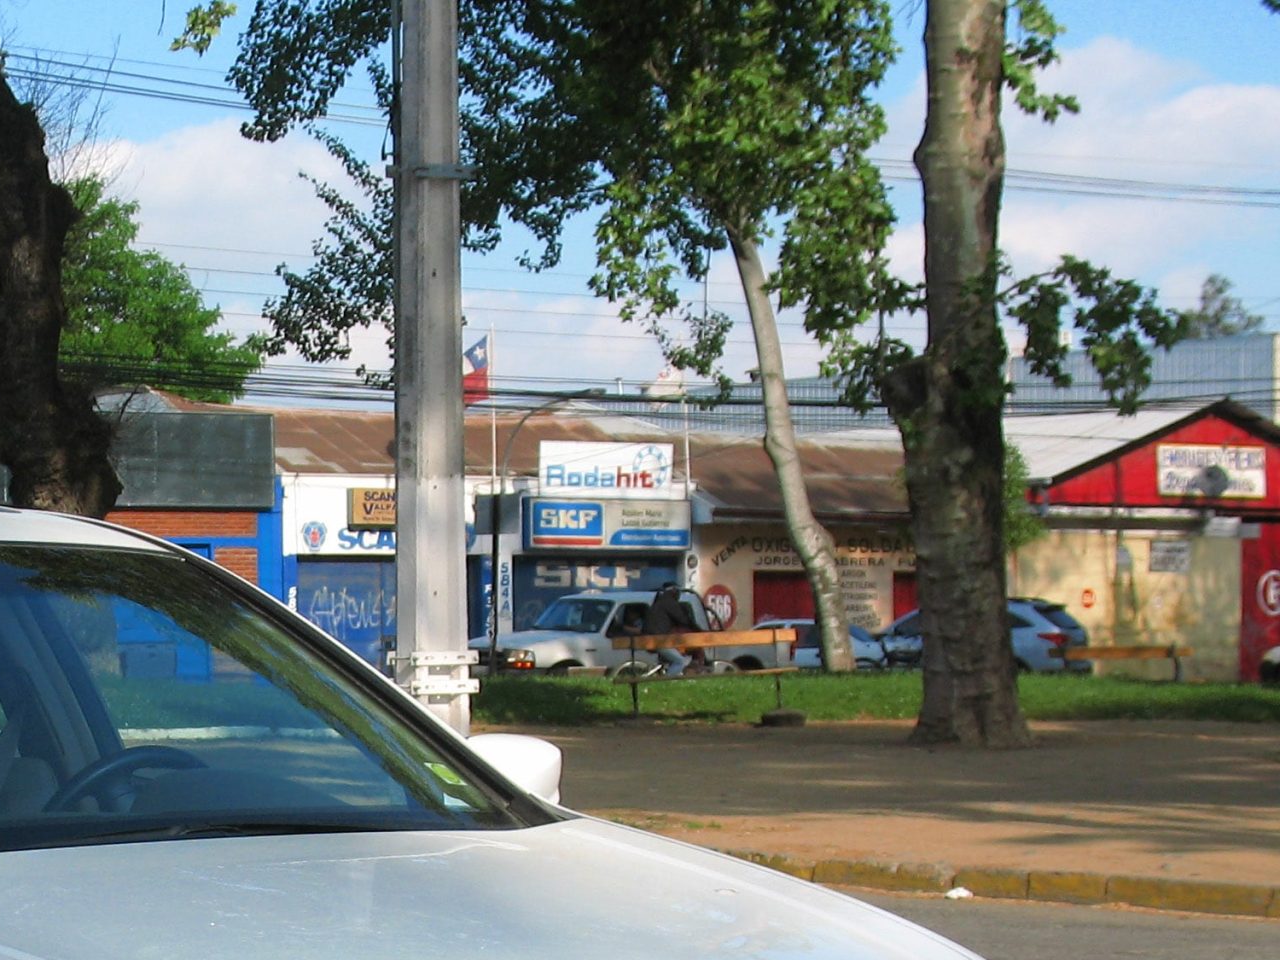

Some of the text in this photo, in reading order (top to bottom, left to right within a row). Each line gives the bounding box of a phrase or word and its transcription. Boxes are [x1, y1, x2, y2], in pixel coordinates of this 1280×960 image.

[546, 464, 654, 488] Rodahit
[540, 509, 597, 529] SKF
[337, 529, 396, 550] SCA
[751, 537, 794, 553] OXIG
[834, 557, 885, 567] ABRERA
[534, 561, 646, 588] SKF
[708, 594, 732, 621] 566
